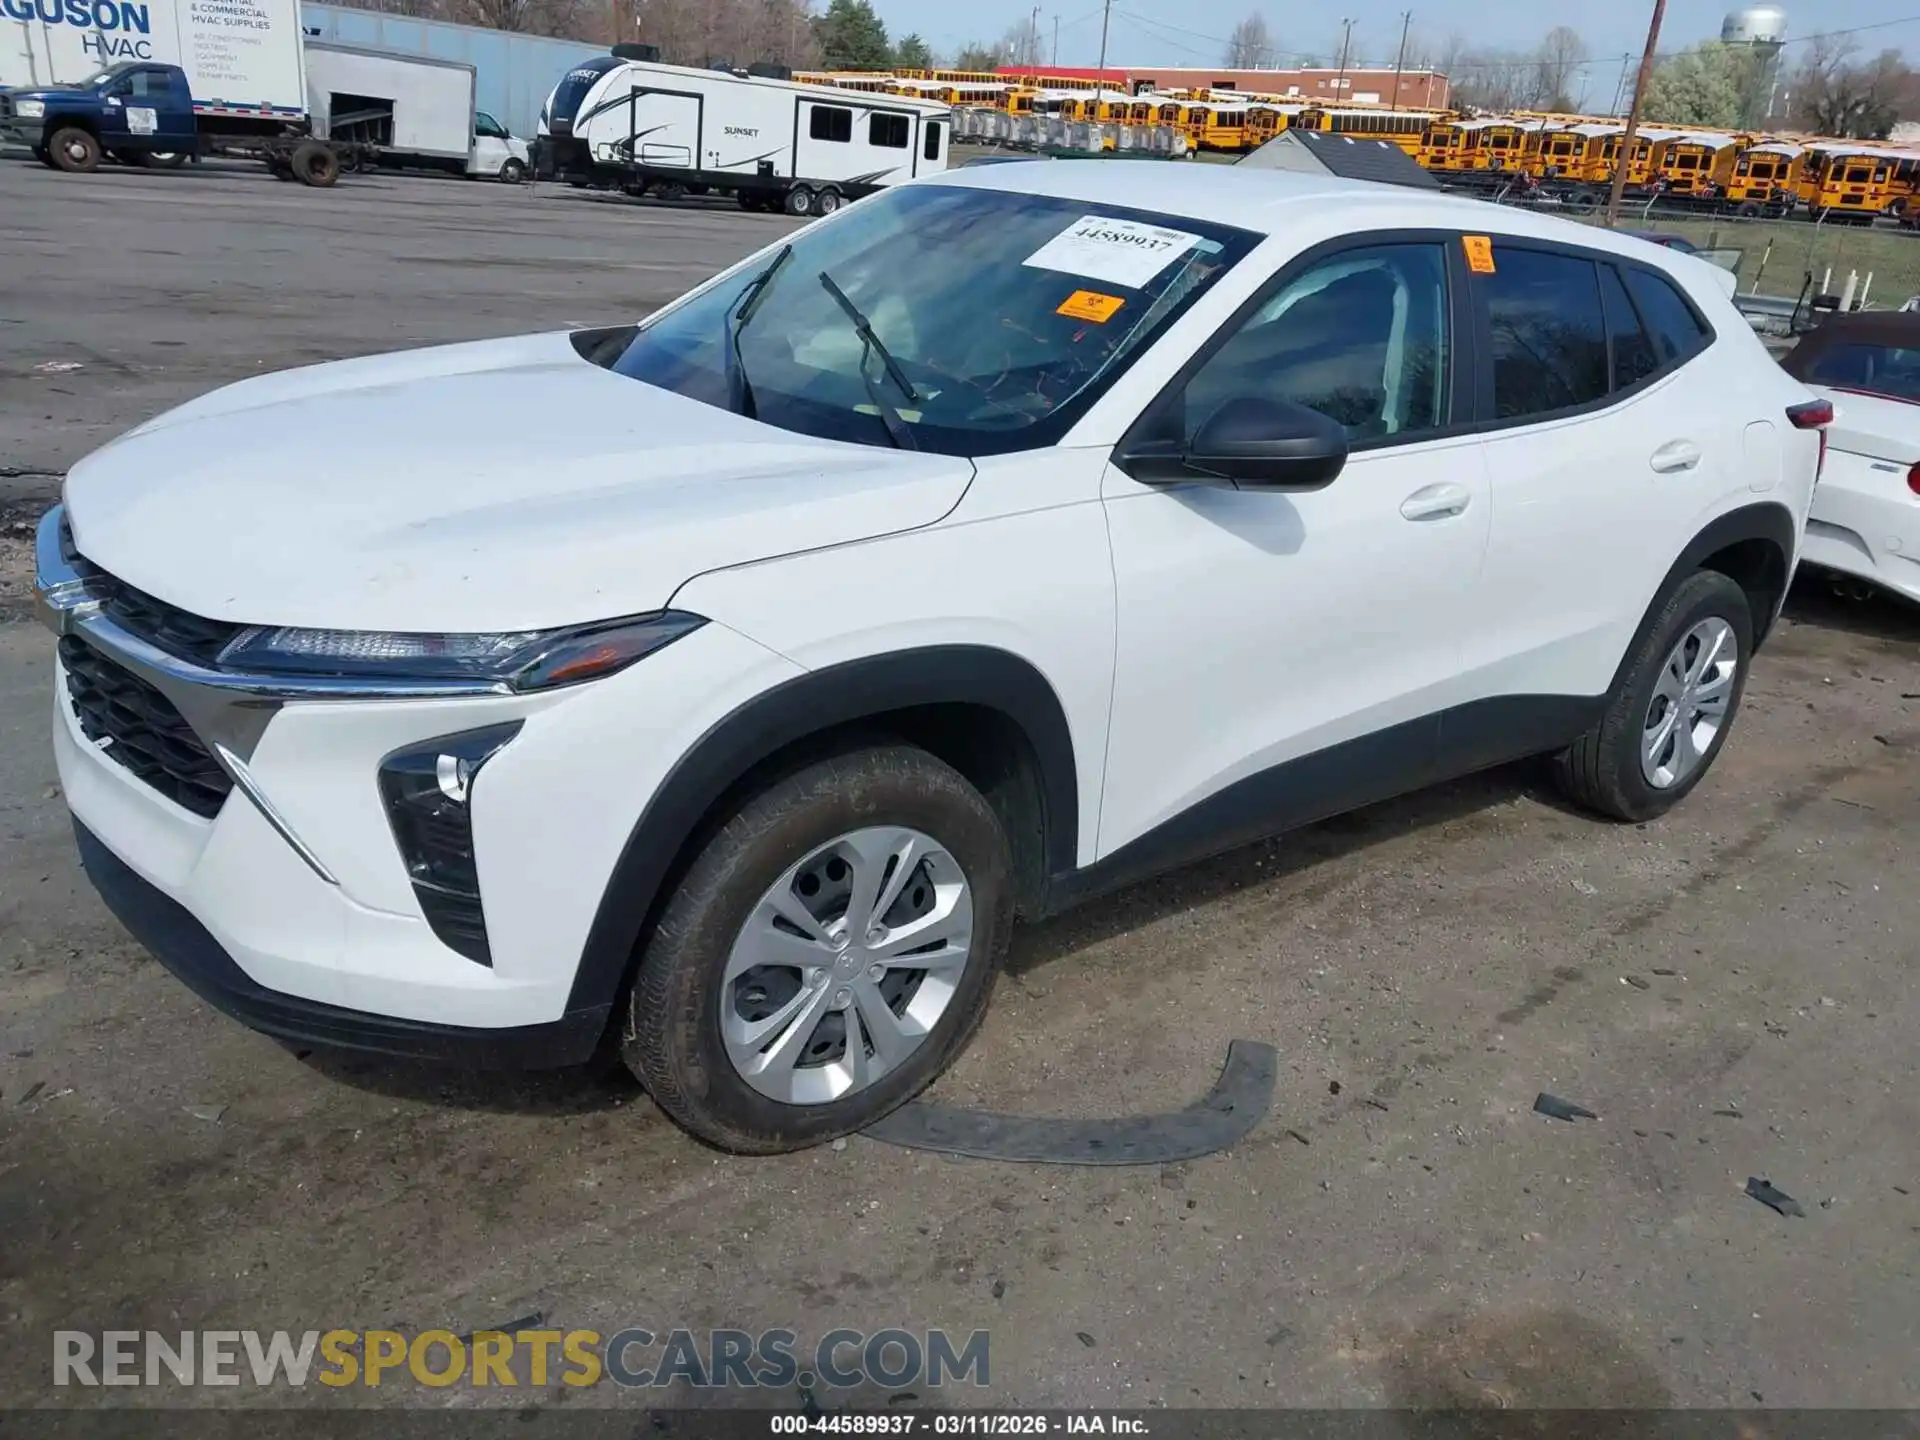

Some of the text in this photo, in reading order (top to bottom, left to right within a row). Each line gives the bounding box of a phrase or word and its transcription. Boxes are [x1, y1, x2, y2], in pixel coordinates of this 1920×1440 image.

[200, 4, 269, 19] COMMERCIAL
[192, 15, 271, 30] HVAC SUPPLIES
[81, 34, 153, 60] HVAC
[723, 125, 760, 138] SUNSET
[1074, 226, 1174, 252] 44589937
